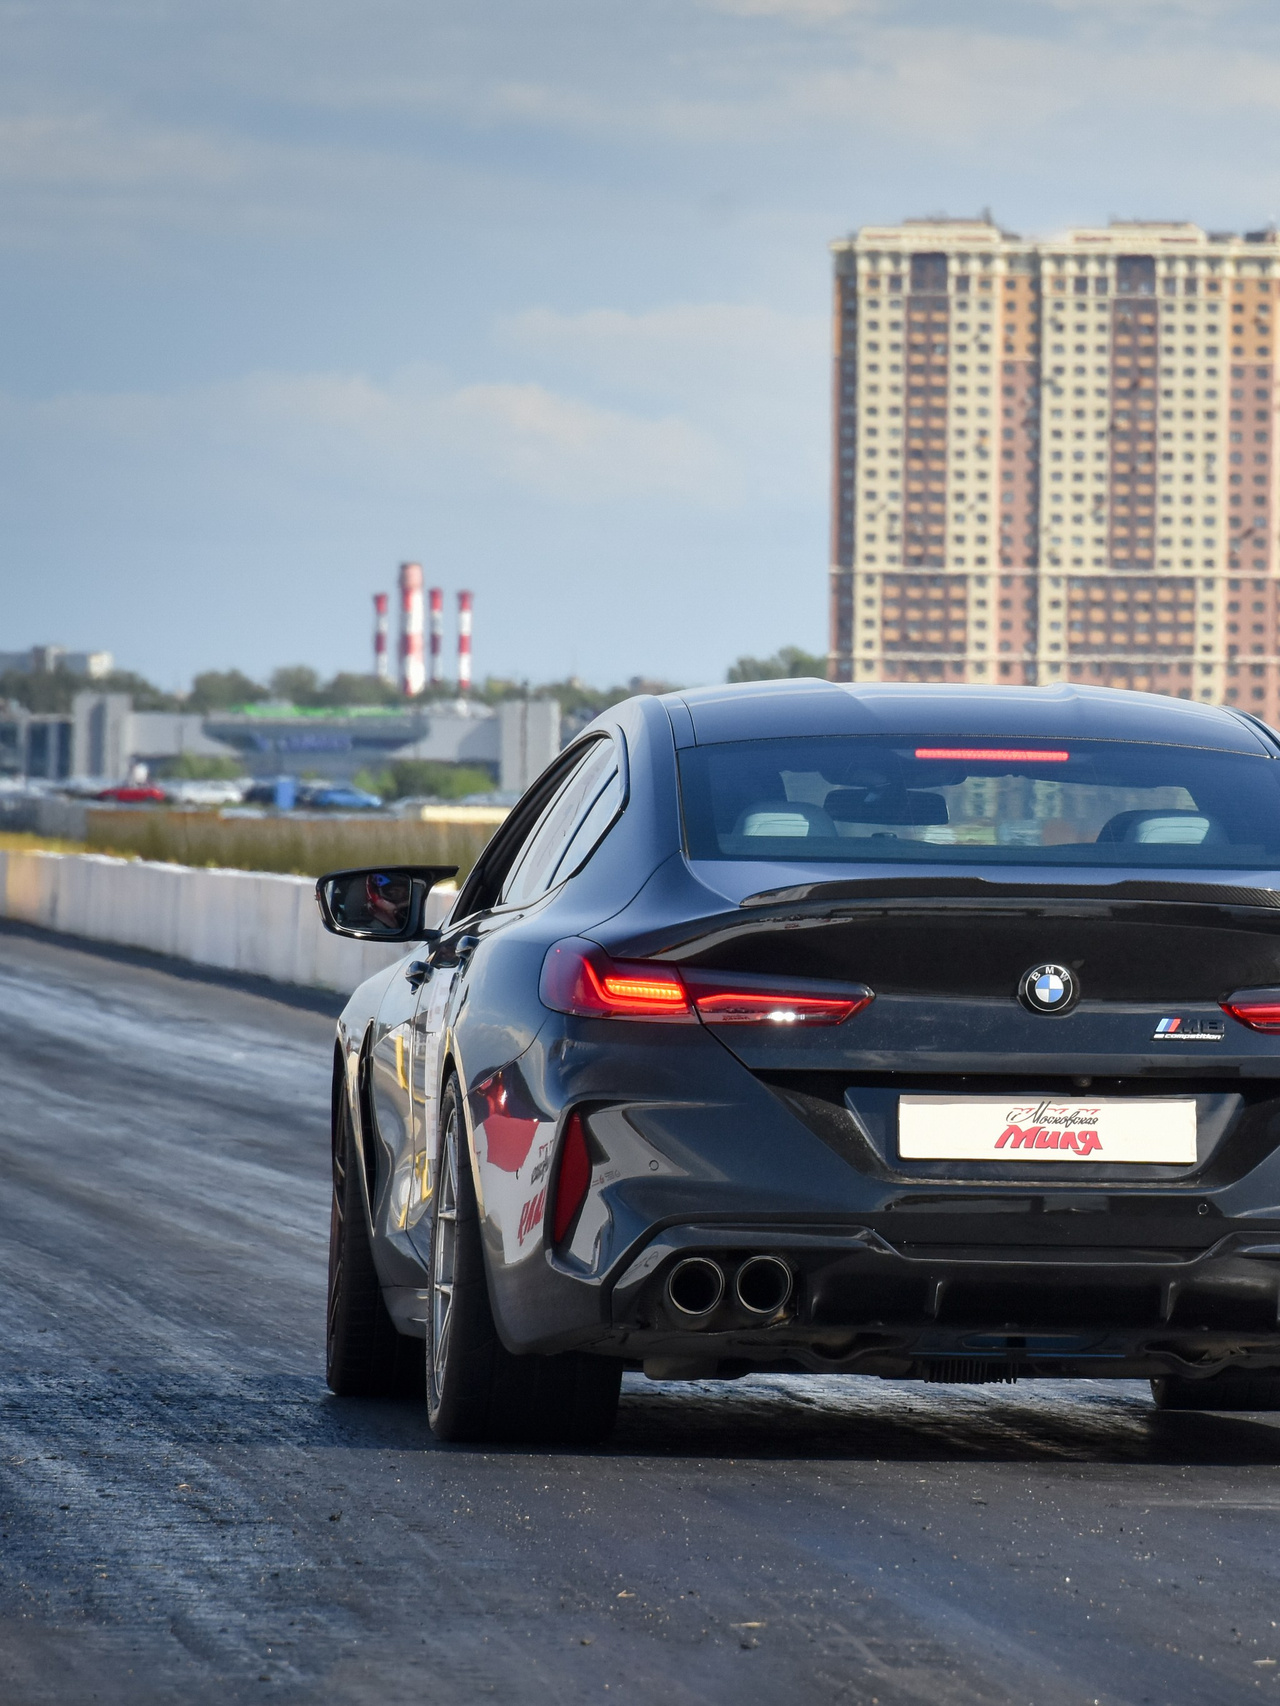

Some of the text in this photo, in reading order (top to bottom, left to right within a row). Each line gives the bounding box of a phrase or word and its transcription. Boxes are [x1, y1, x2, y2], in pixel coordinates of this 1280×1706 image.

[1031, 966, 1070, 982] BMW
[1006, 1100, 1098, 1128] Московская
[994, 1124, 1103, 1156] Миля
